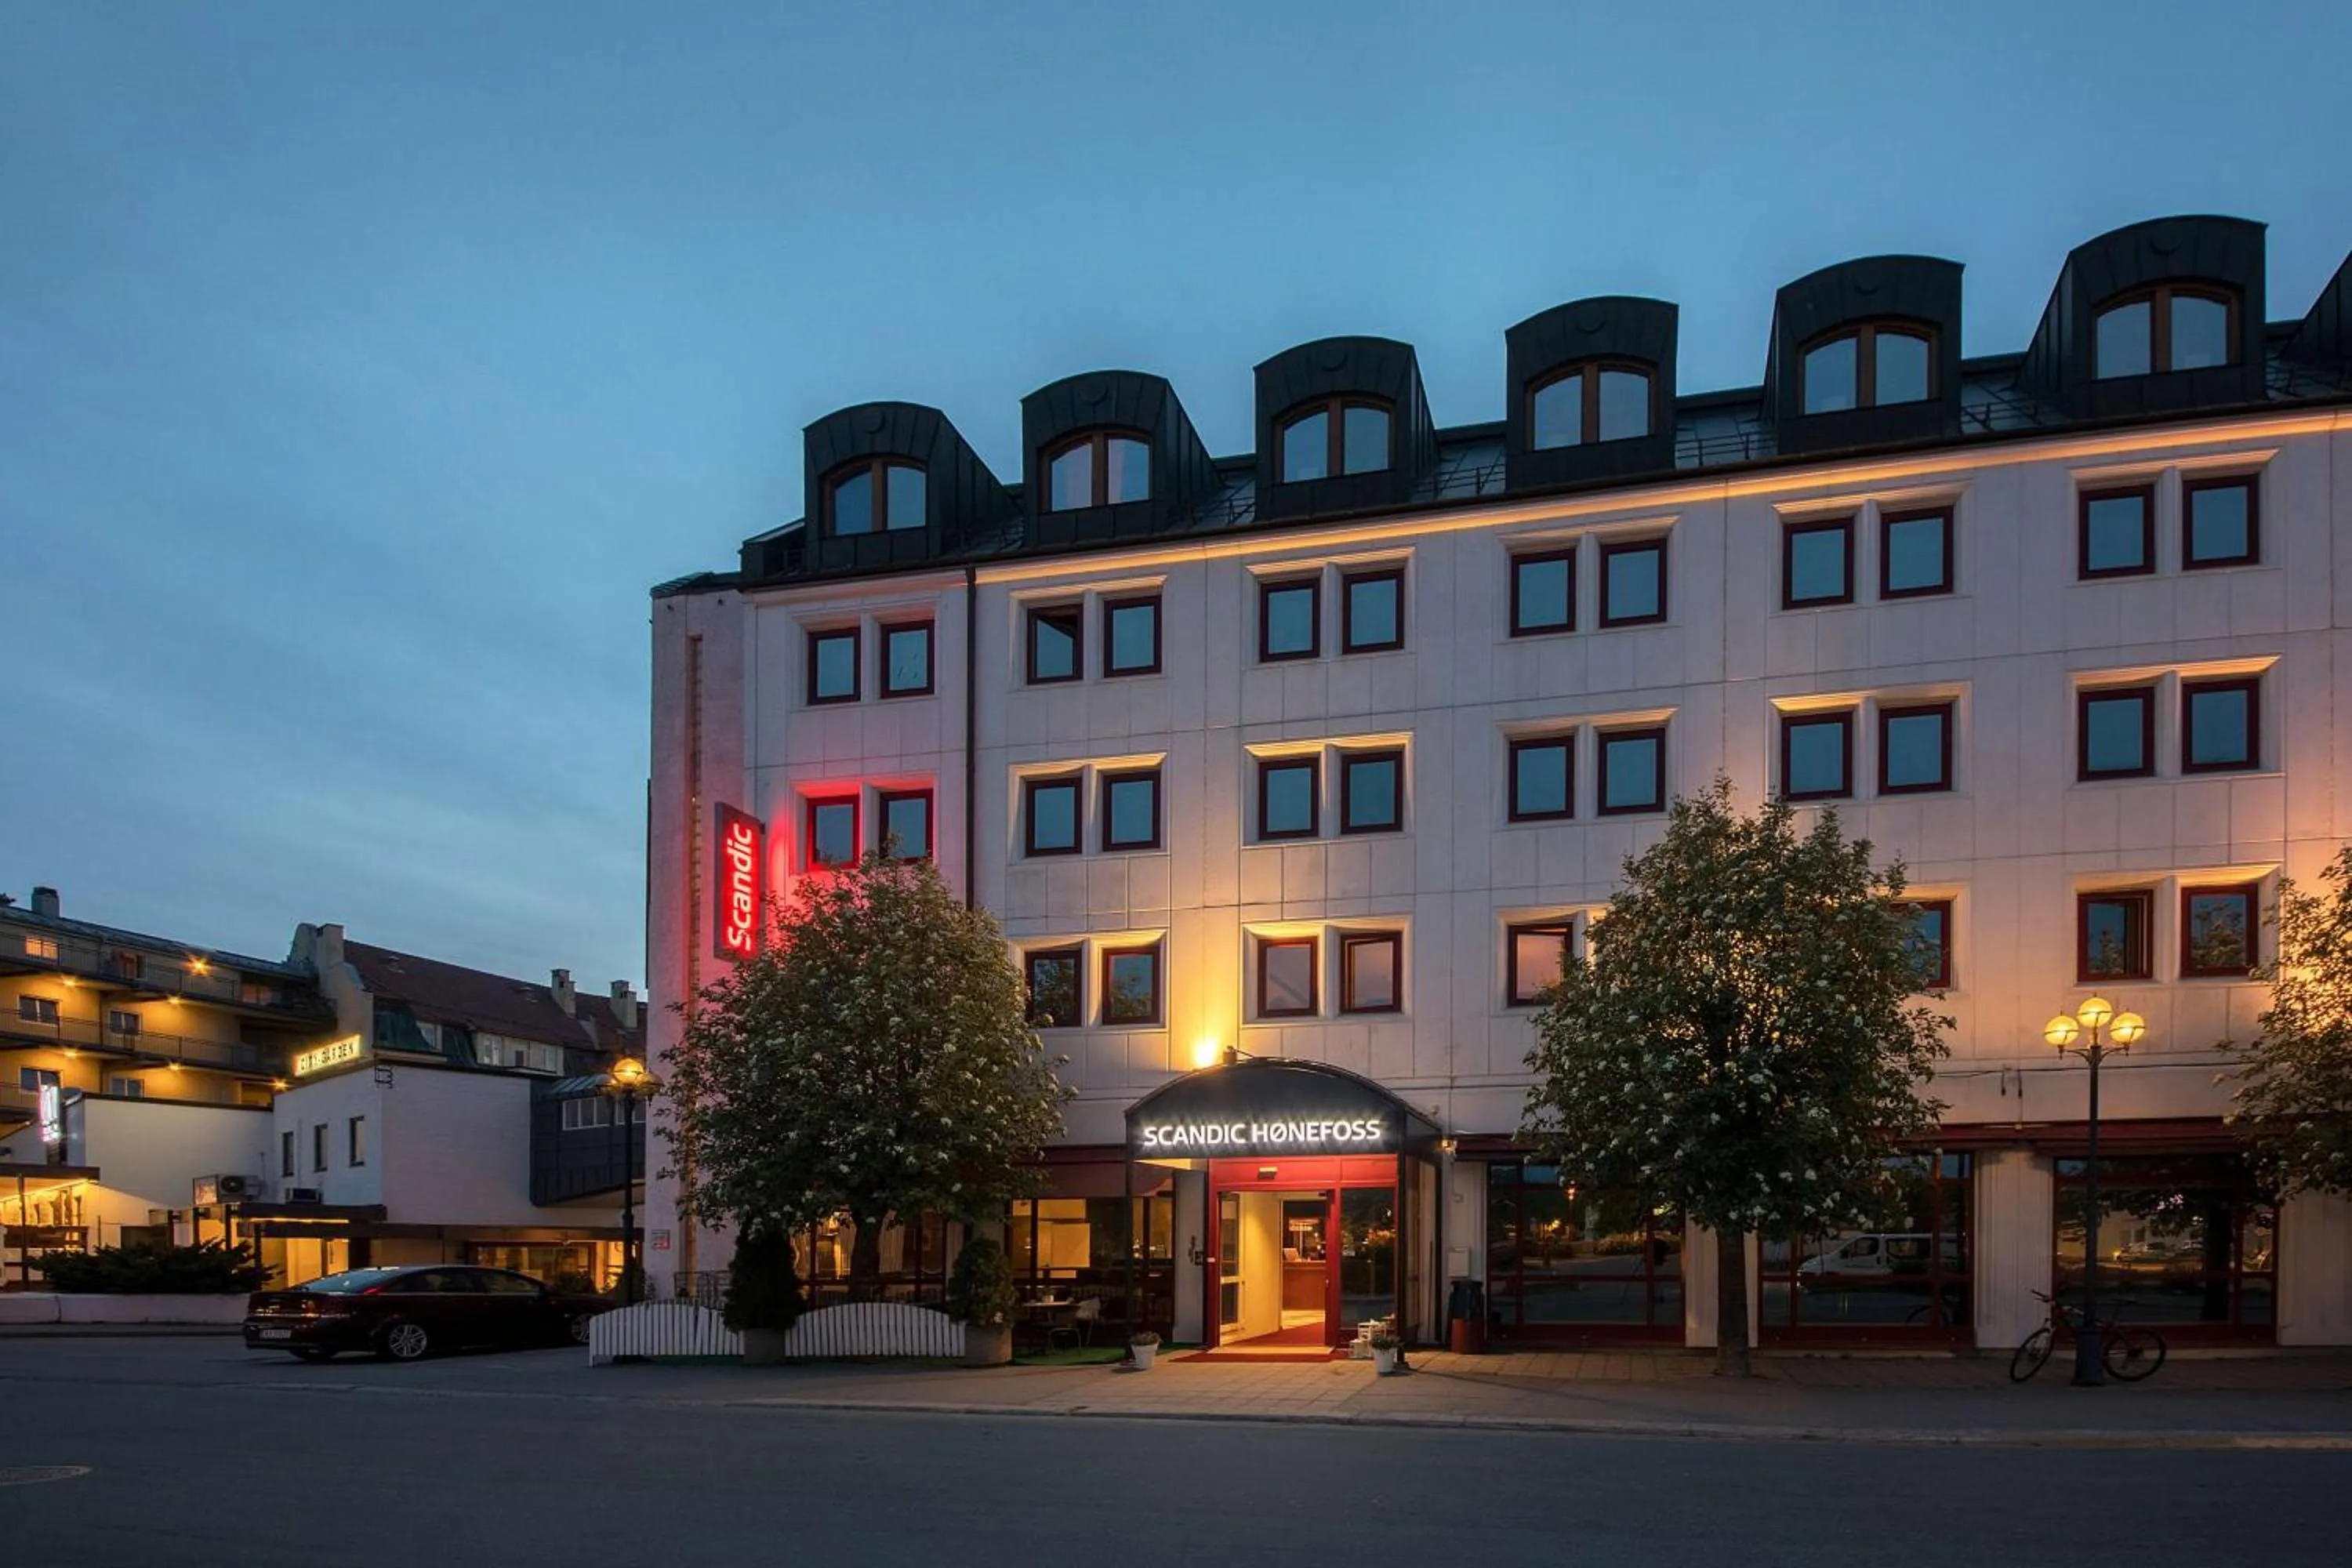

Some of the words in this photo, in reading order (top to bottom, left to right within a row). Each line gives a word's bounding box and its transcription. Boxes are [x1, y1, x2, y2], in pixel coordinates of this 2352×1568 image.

[727, 822, 752, 951] Scandic
[1143, 1123, 1246, 1146] SCANDIC
[1252, 1120, 1381, 1143] HØNEFOSS
